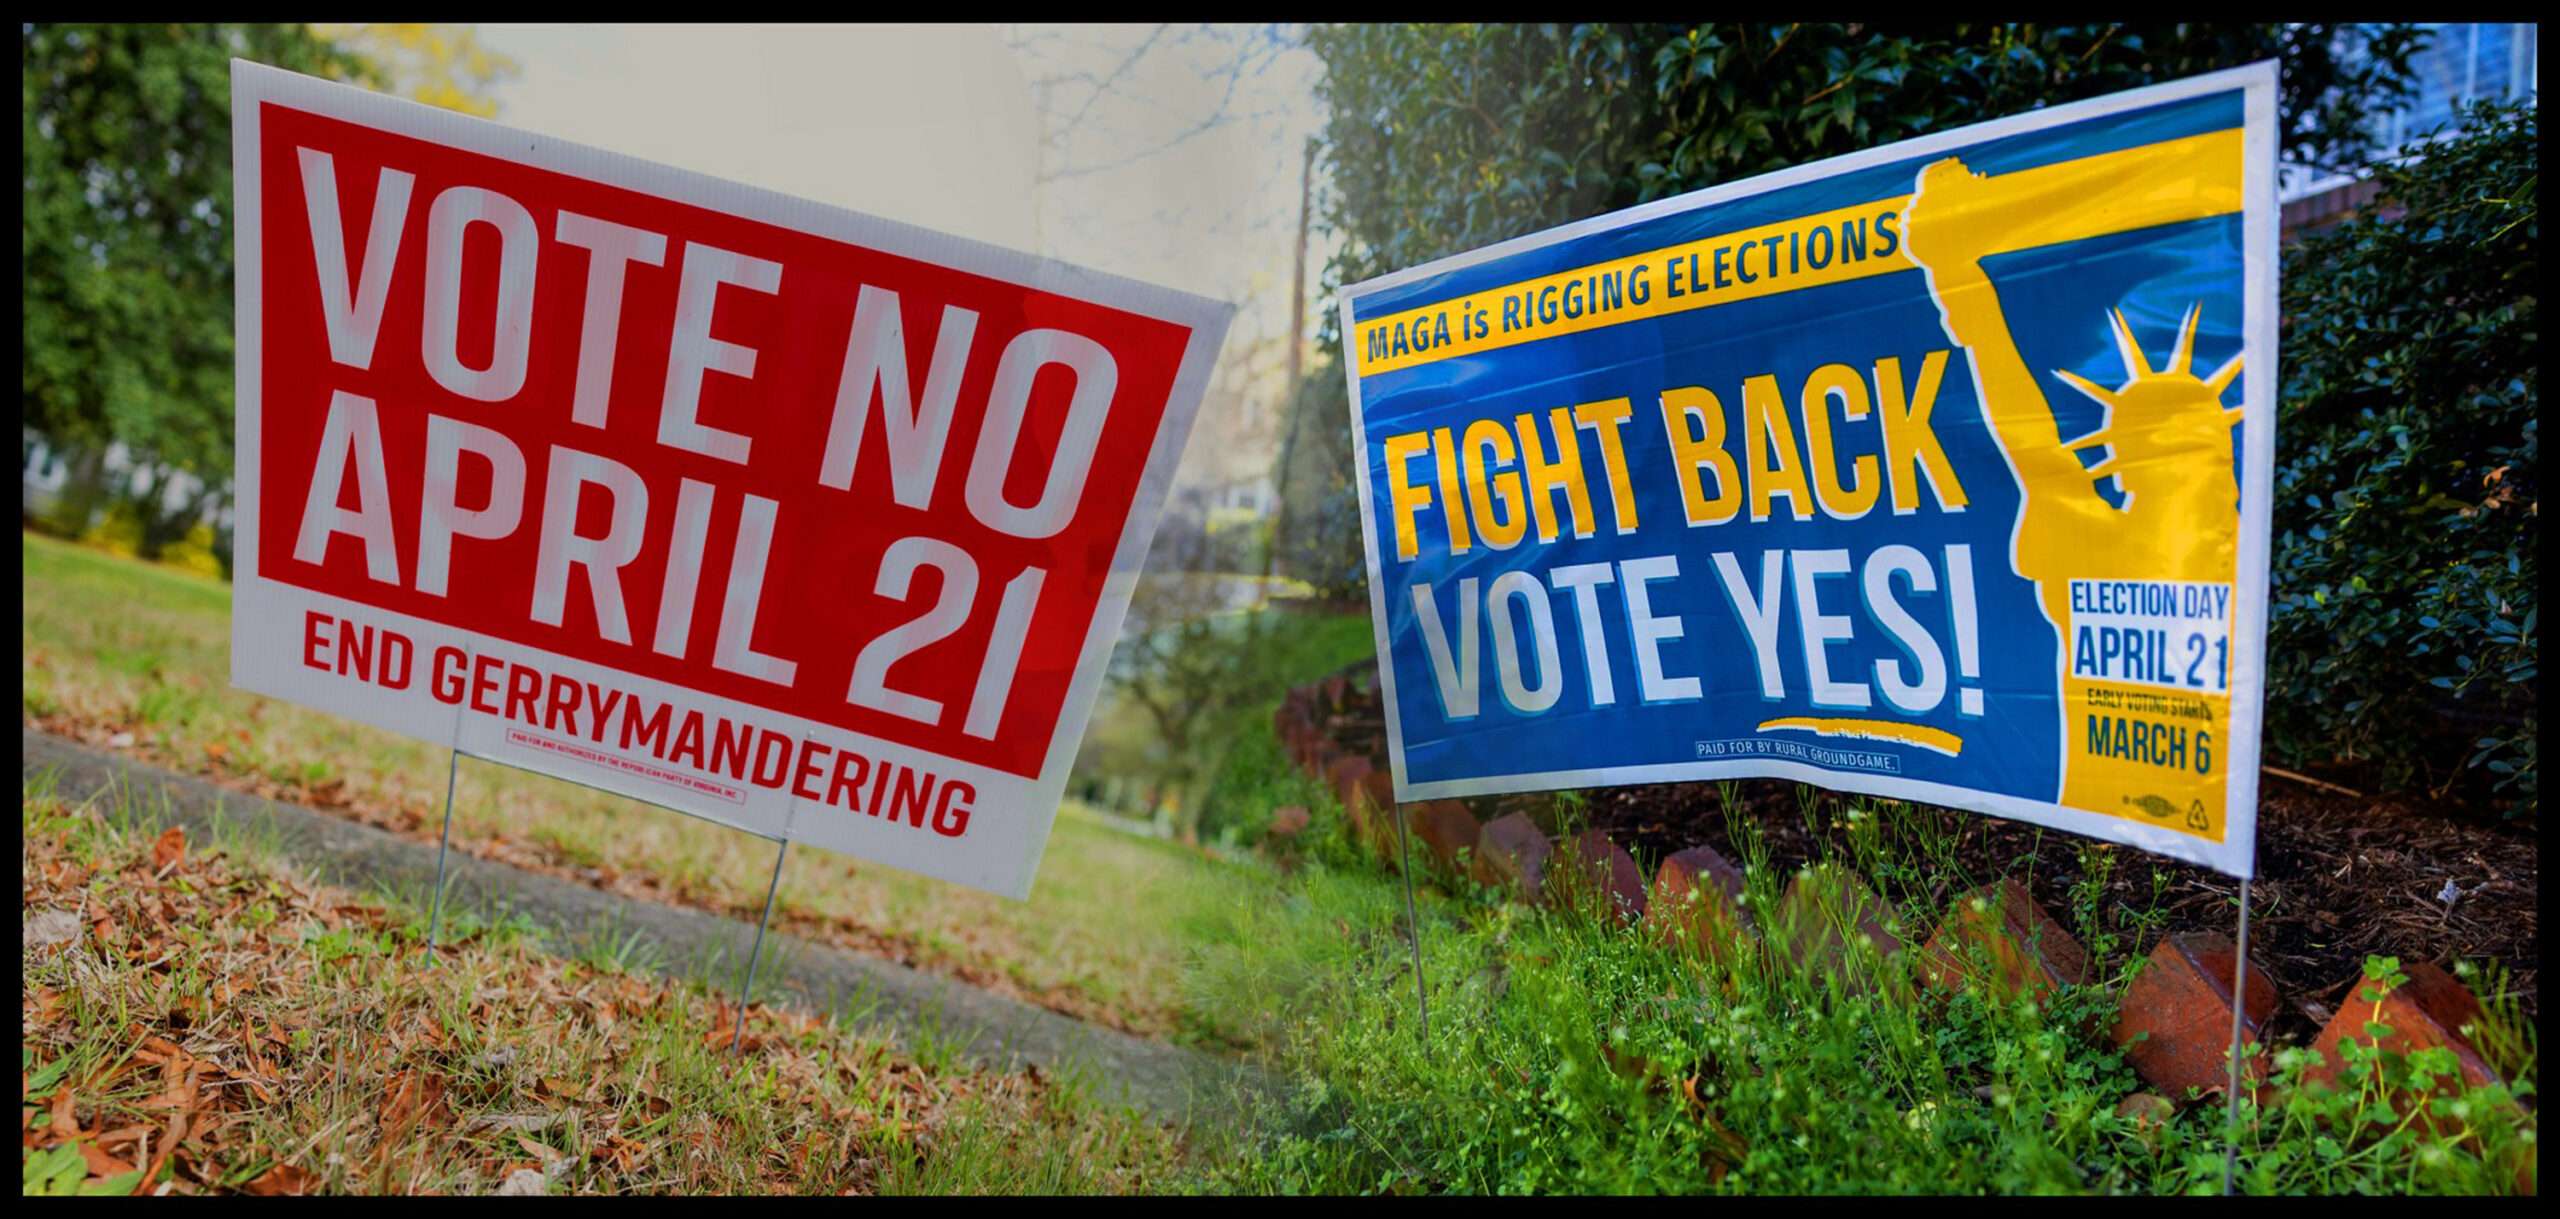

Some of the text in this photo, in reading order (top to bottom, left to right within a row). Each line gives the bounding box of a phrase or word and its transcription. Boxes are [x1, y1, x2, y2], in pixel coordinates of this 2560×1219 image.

[296, 146, 1119, 539] VOTE NO
[1368, 211, 1898, 363] MAGA is RIGGING ELECTIONS
[1385, 349, 1969, 562] FIGHT BACK
[293, 388, 1048, 741] APRIL 21
[1412, 544, 1984, 722] VOTE YES!
[2071, 581, 2230, 620] ELECTION DAY
[303, 610, 977, 838] END GERRYMANDERING
[2074, 625, 2228, 690] APRIL 21
[1698, 741, 1896, 770] PAID FOR BY RURAL GROUNDGAME.
[2087, 715, 2212, 775] MARCH 6
